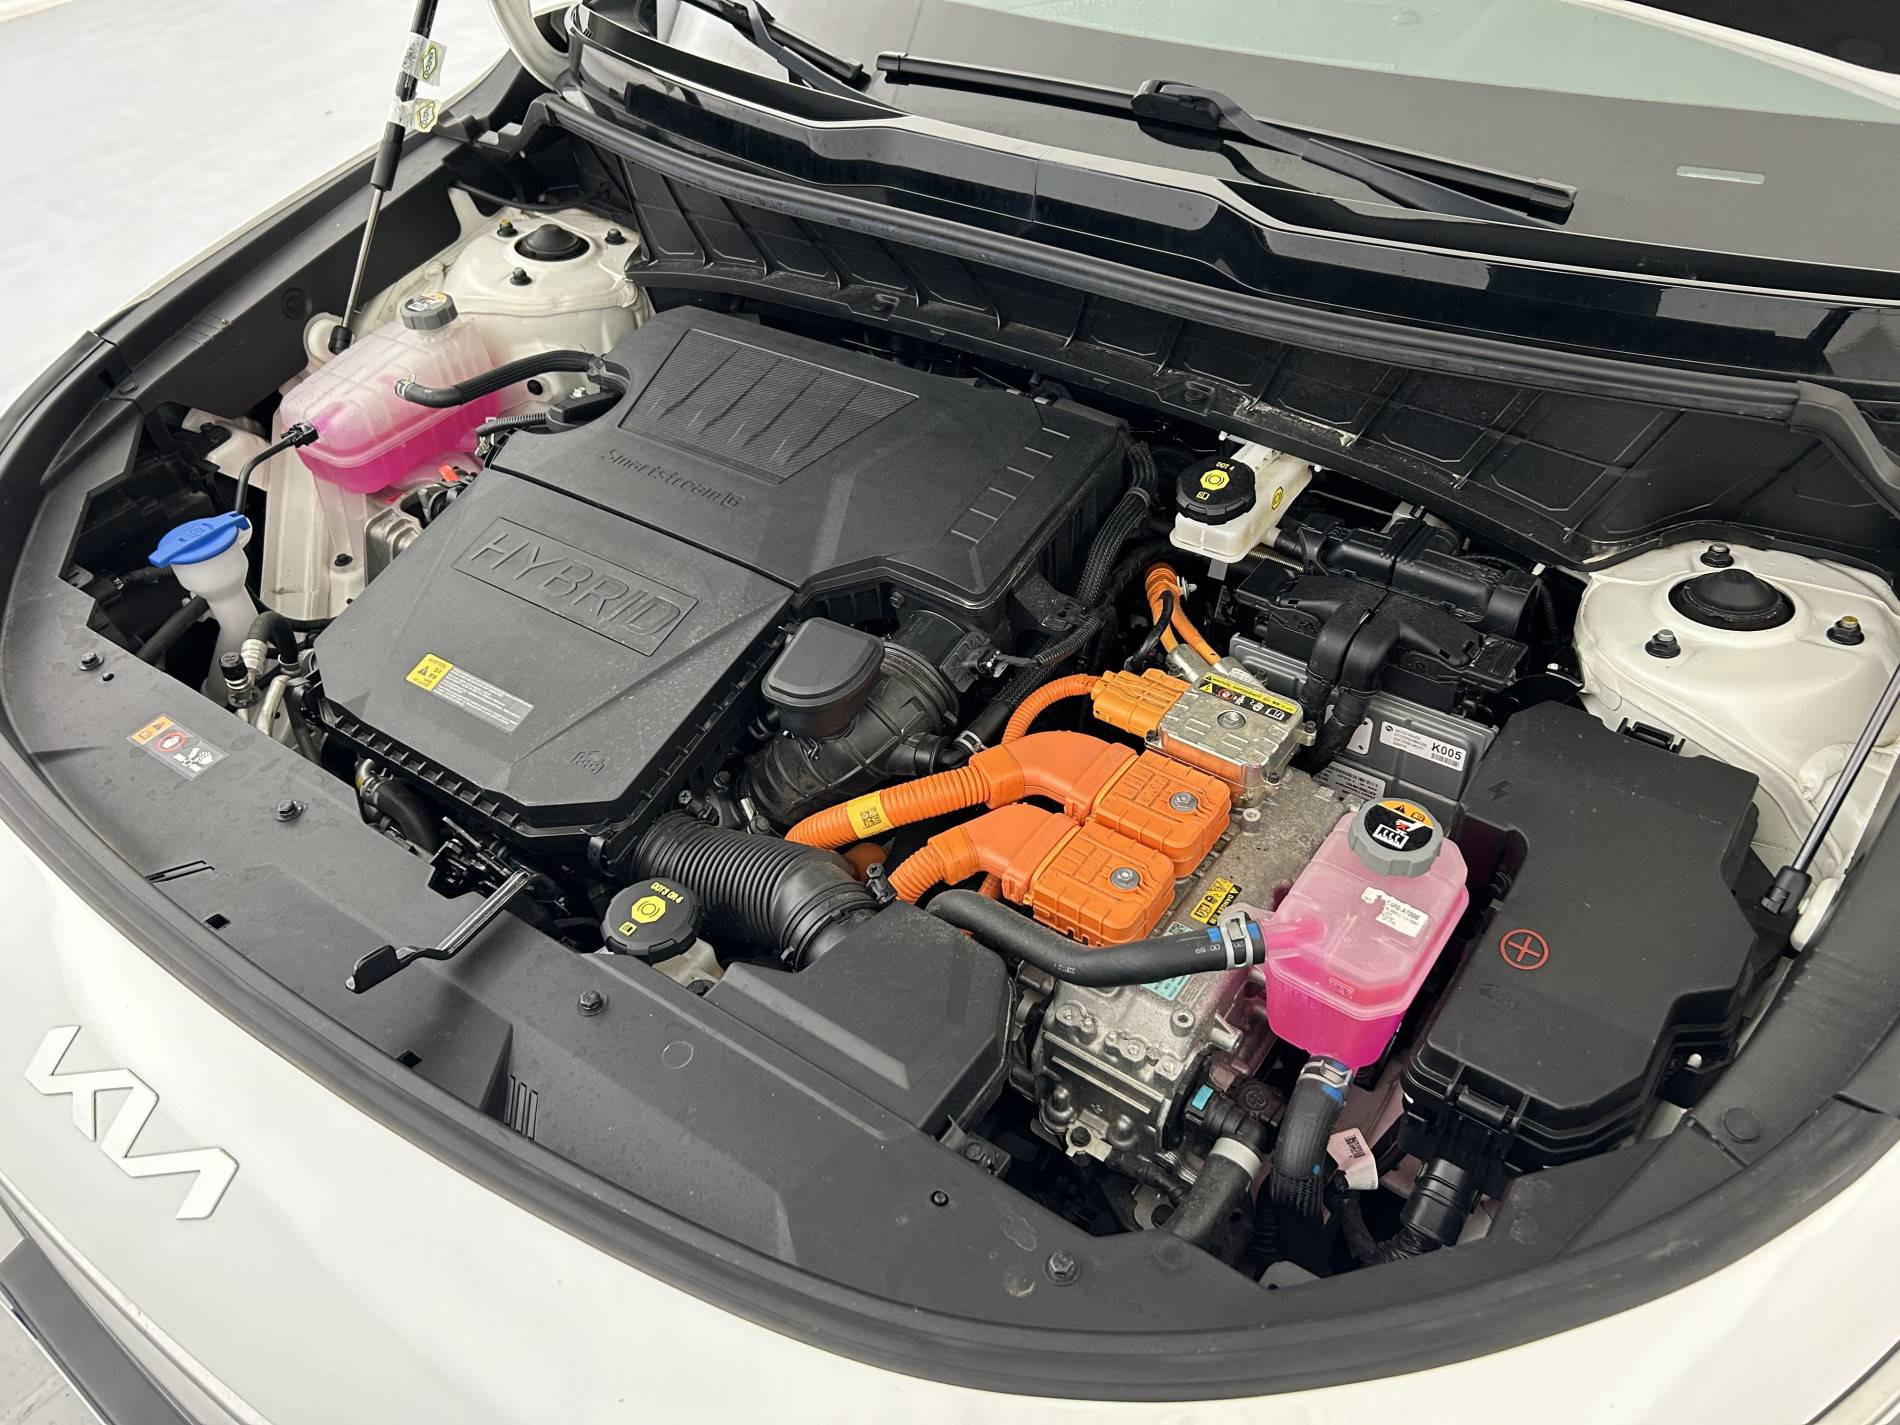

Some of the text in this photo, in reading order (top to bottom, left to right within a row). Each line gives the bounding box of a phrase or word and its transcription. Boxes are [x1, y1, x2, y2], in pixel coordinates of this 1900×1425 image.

[1215, 461, 1230, 470] DOT
[468, 533, 681, 635] HYBRID
[1431, 742, 1462, 761] K005
[24, 1024, 240, 1221] KIA
